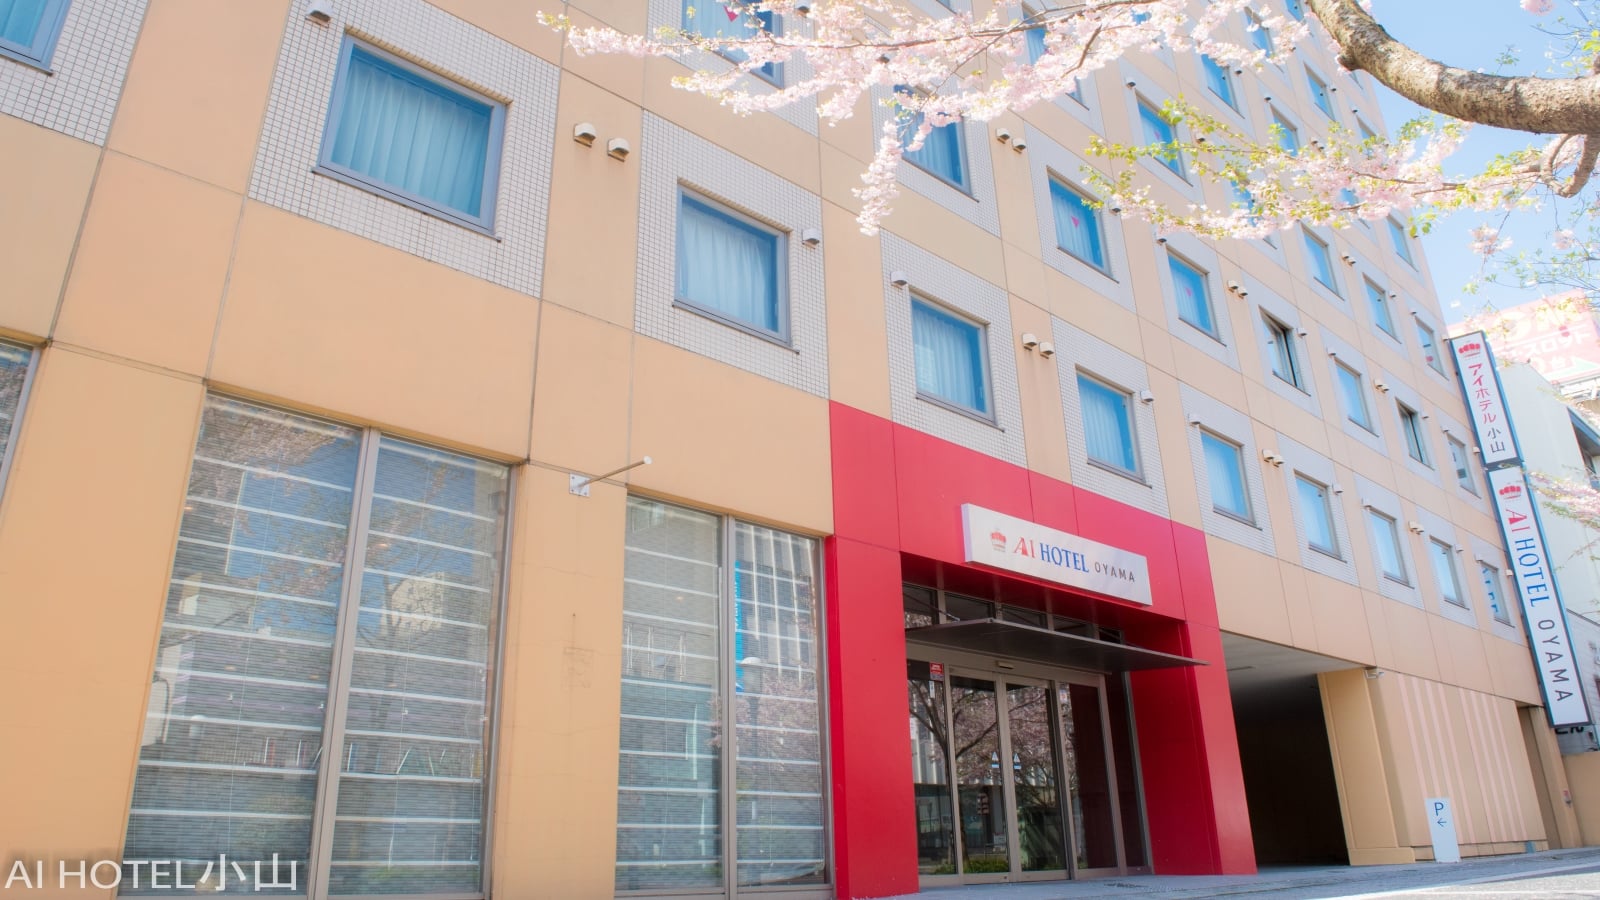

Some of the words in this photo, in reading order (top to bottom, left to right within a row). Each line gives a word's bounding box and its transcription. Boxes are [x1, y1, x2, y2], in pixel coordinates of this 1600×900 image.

[1505, 508, 1531, 533] AI
[1013, 536, 1036, 559] AI
[1039, 542, 1090, 573] HOTEL
[1094, 562, 1136, 583] OYAMA
[1514, 537, 1550, 608] HOTEL
[1537, 619, 1574, 702] OYAMA
[1433, 802, 1444, 817] P
